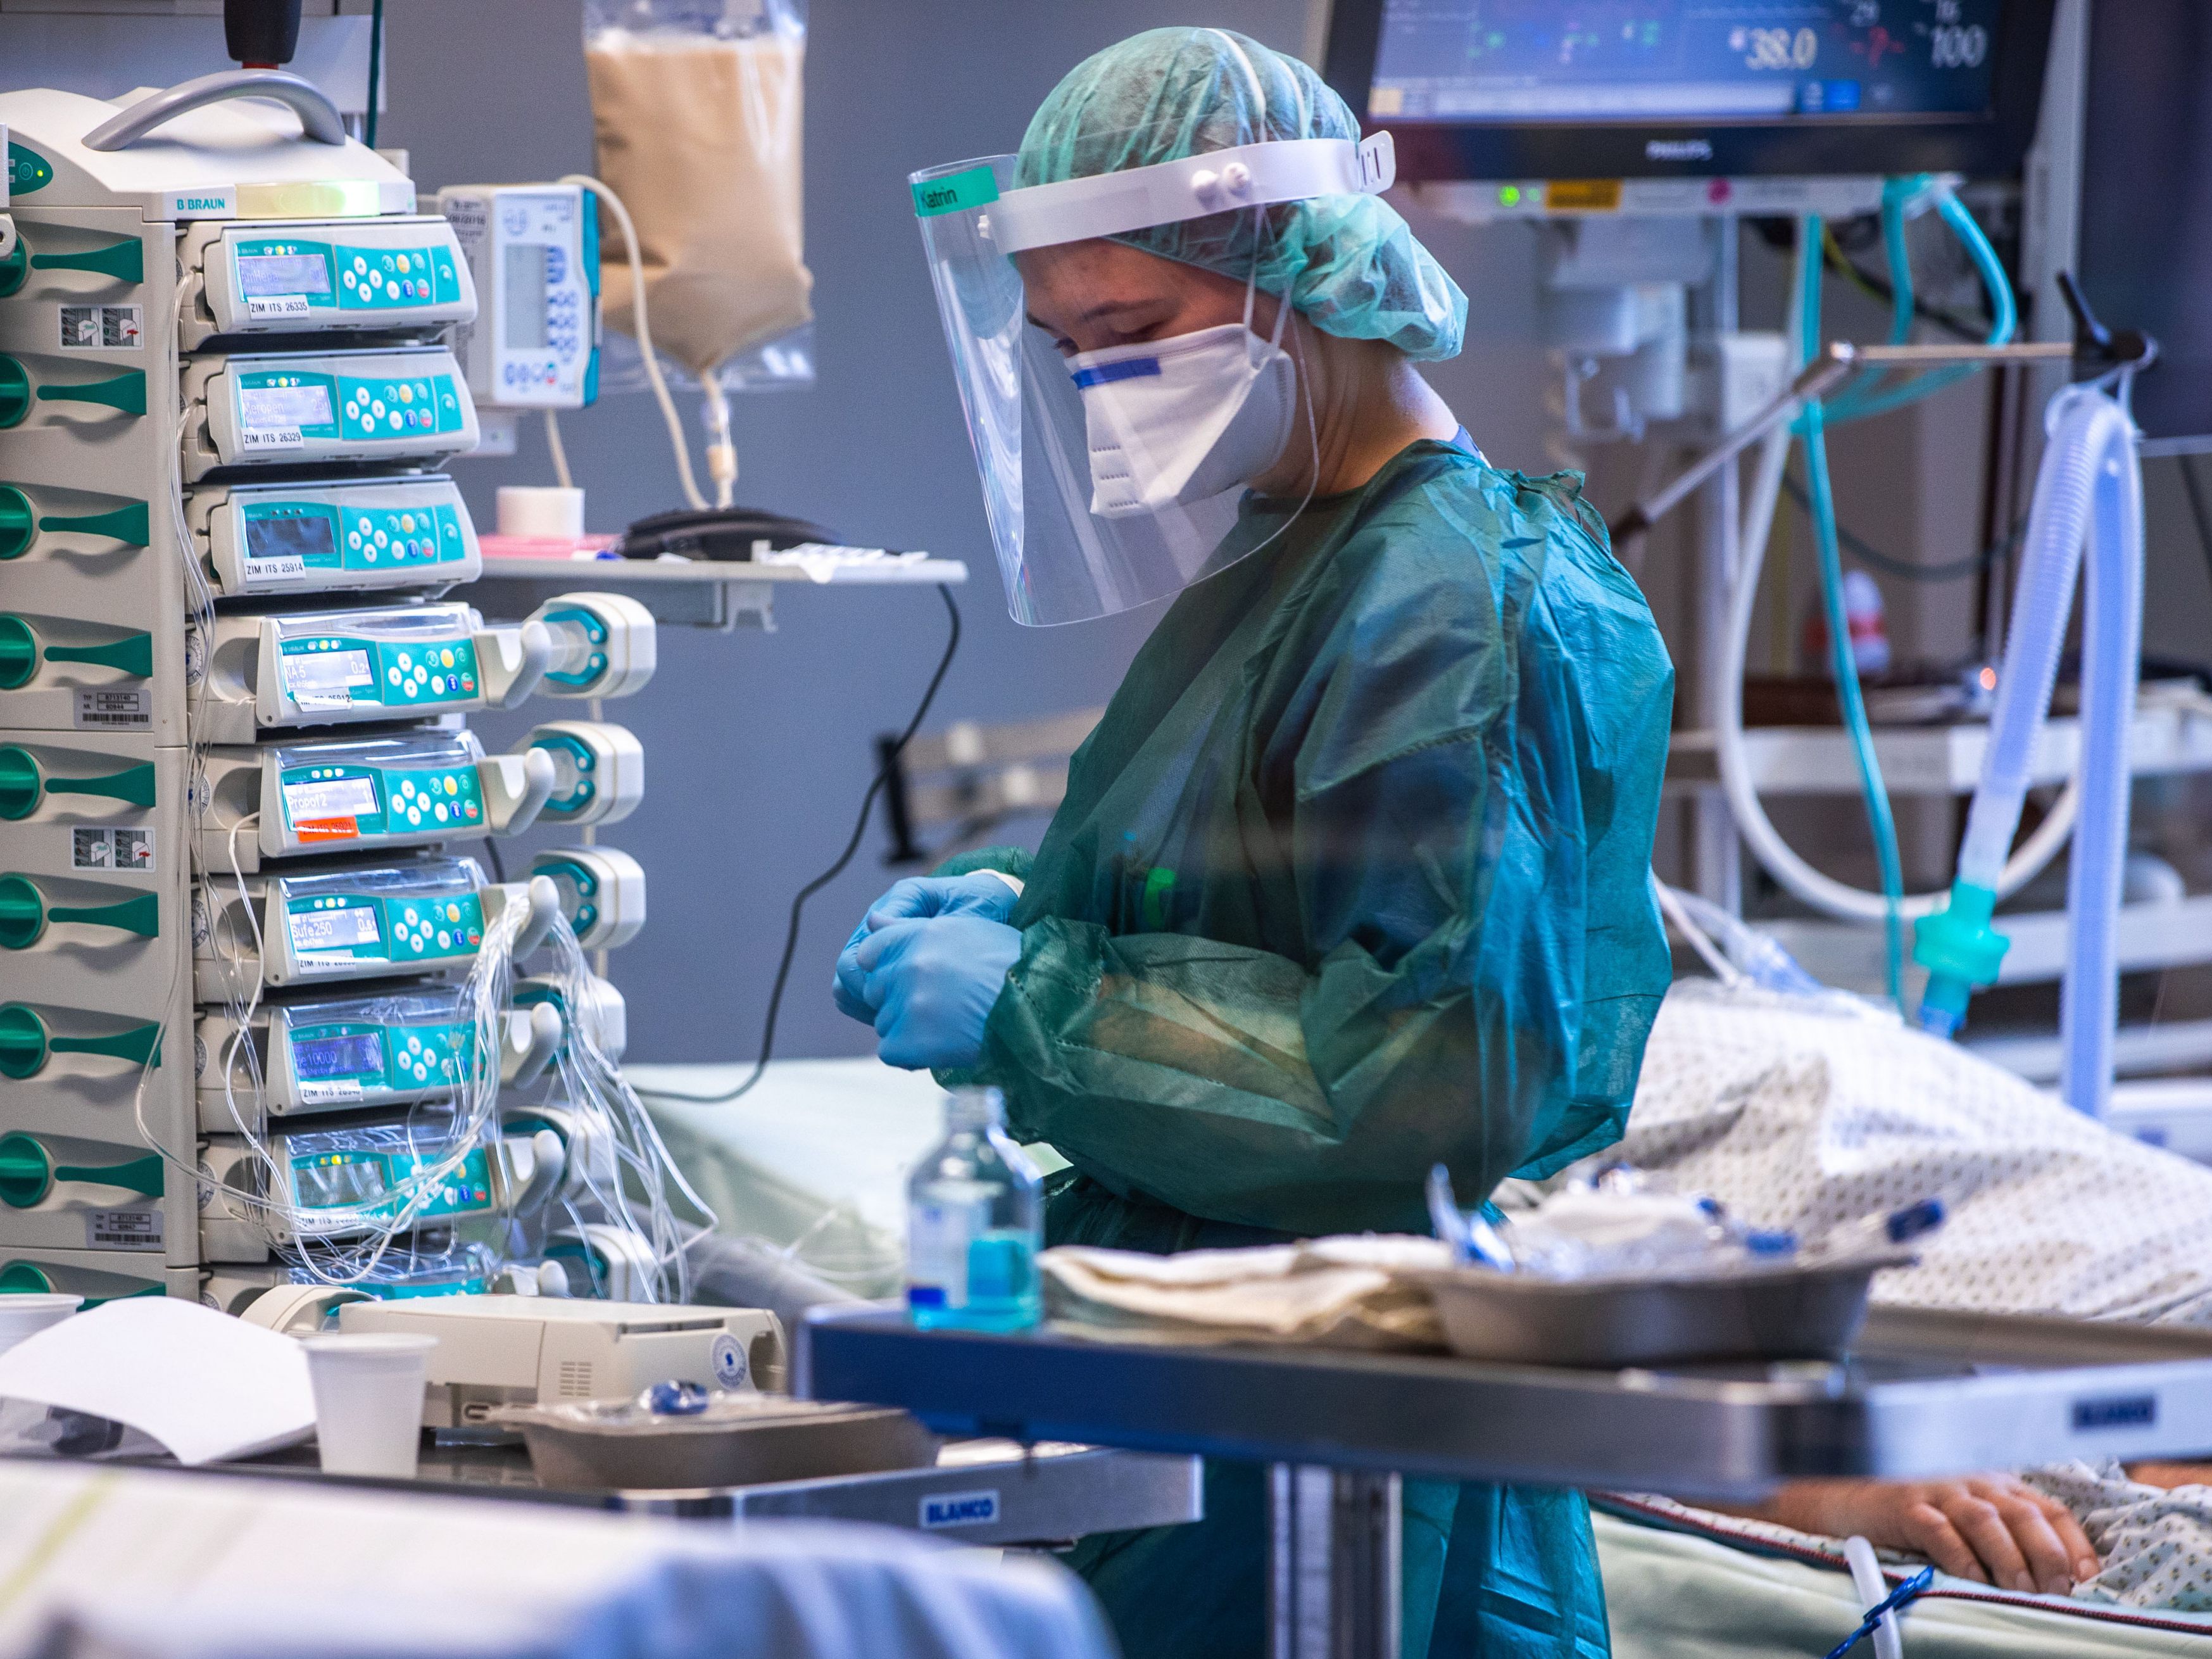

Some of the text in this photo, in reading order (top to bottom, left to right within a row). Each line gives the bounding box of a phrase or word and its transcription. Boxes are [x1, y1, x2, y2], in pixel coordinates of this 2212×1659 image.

[1930, 24, 1988, 68] 100
[187, 198, 225, 210] BRAUN
[250, 302, 308, 313] ZIM ITS 26335
[244, 432, 301, 444] ZIM ITS 26329
[246, 564, 303, 575] ZIM ITS 25914
[284, 665, 299, 679] NA
[304, 1089, 318, 1097] ZIM
[927, 1499, 994, 1523] BLANCO
